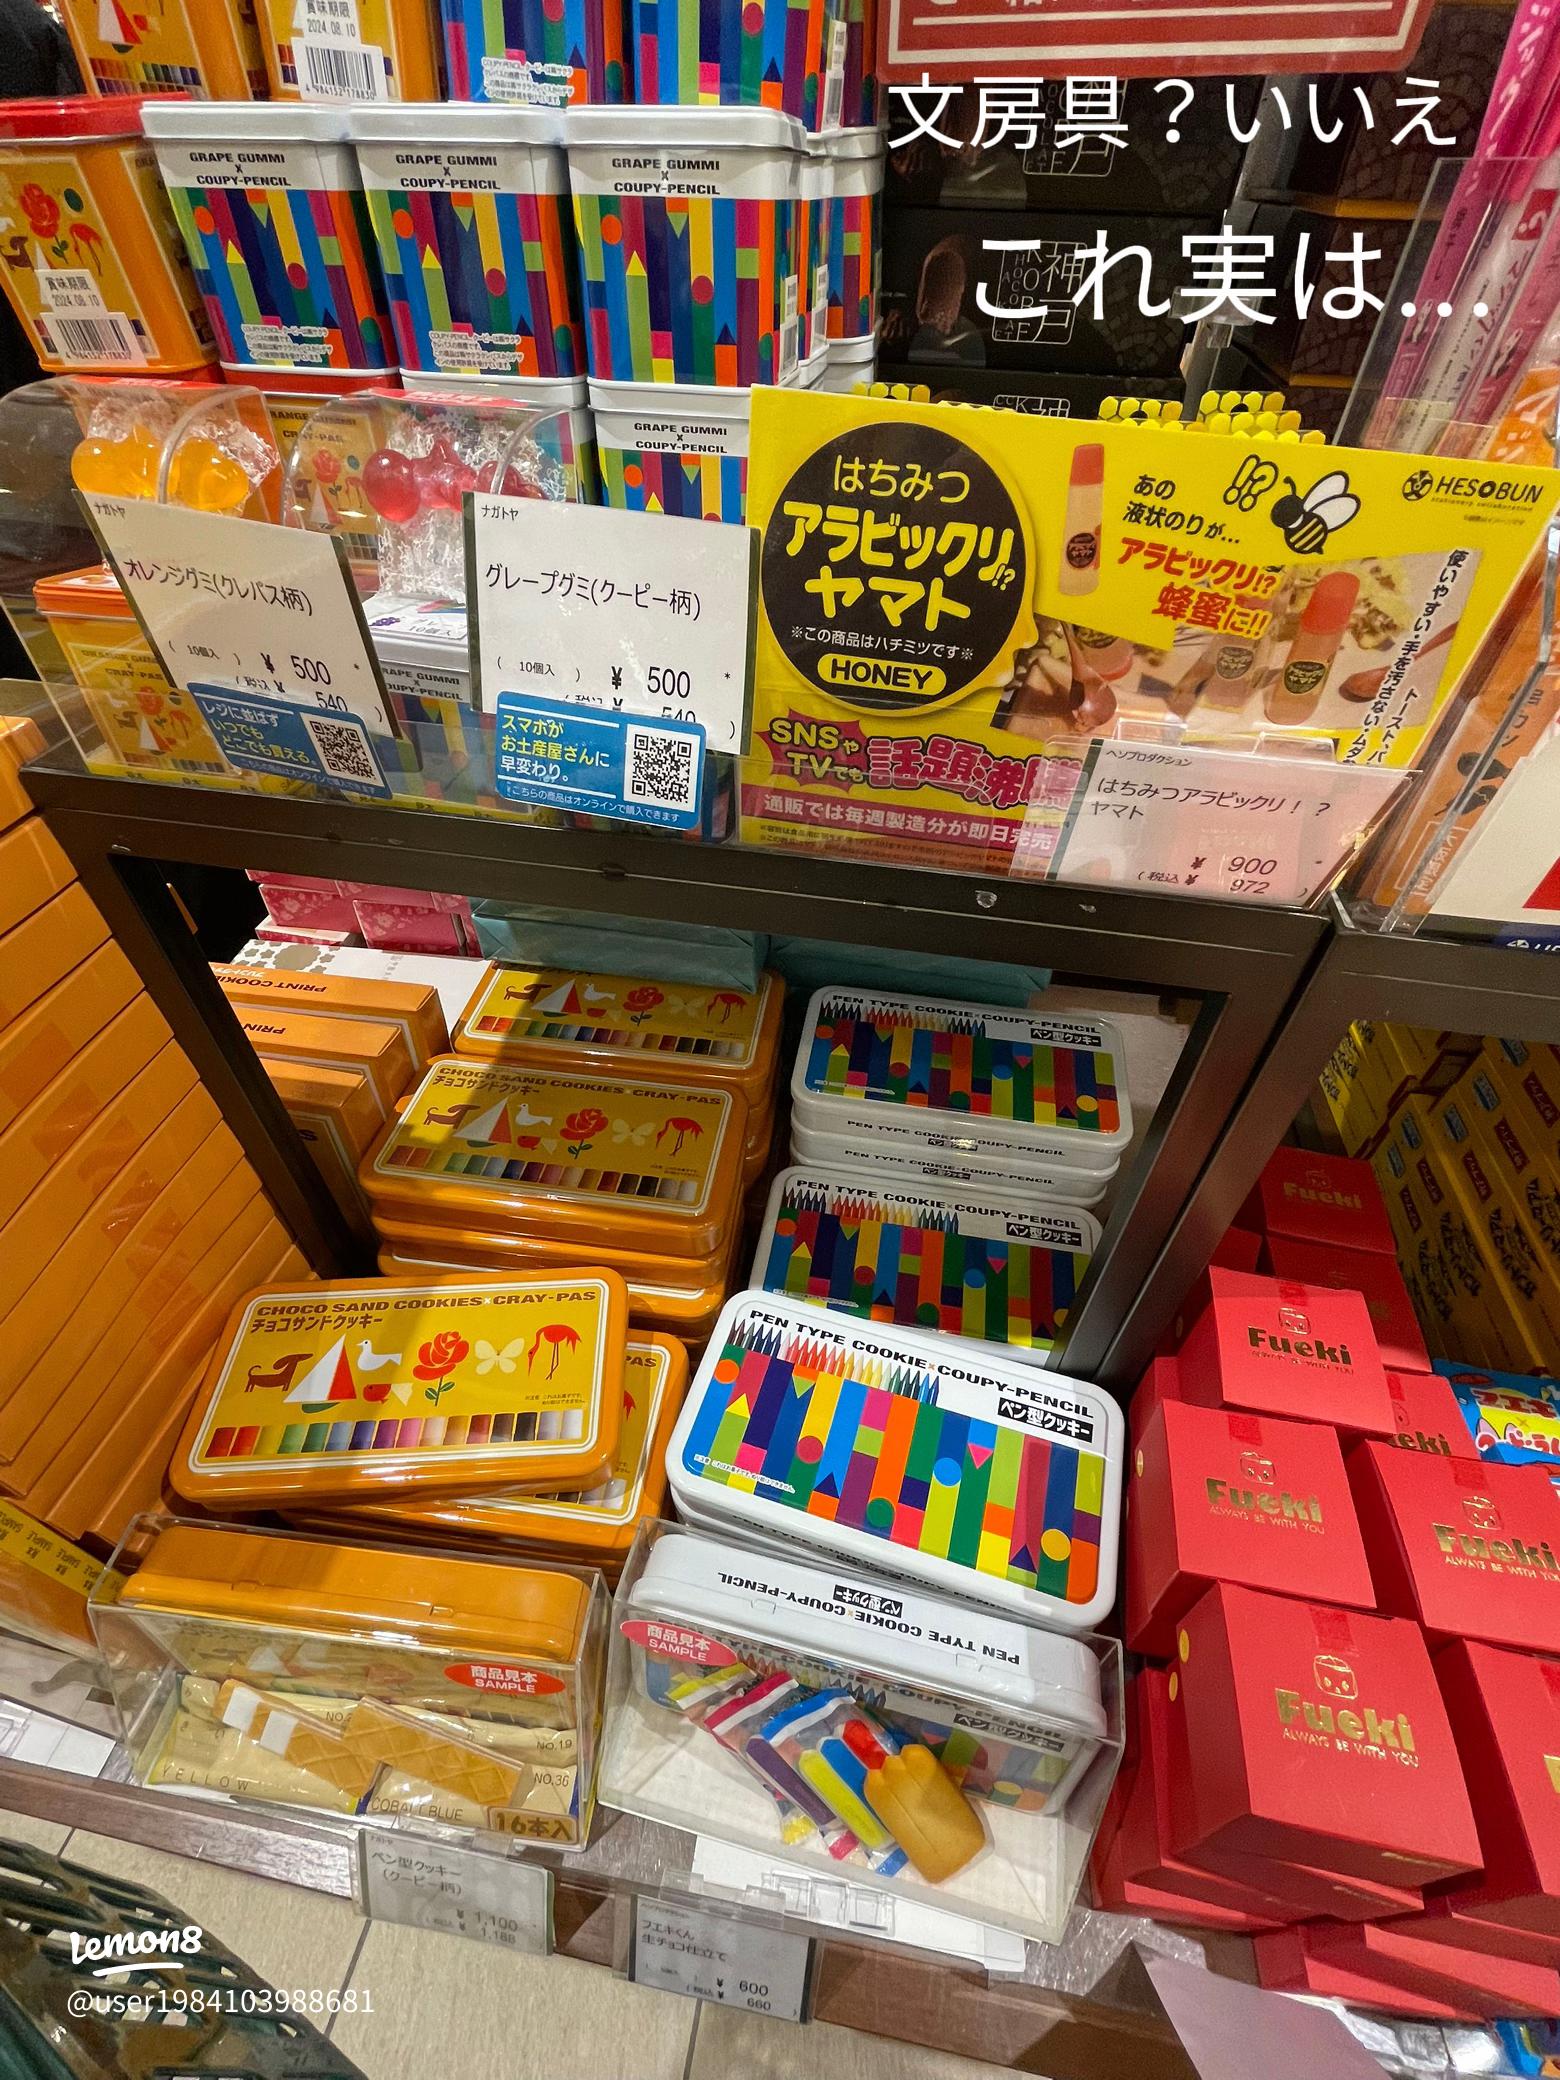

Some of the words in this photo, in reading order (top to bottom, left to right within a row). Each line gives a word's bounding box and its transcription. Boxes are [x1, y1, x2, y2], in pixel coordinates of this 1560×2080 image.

[190, 152, 233, 163] GRAPE
[237, 153, 285, 163] GUMMI
[396, 154, 443, 166] GRAPE
[446, 155, 498, 167] GUMMI
[612, 158, 661, 170] GRAPE
[666, 159, 720, 170] GUMMI
[196, 175, 292, 187] COUPY-PENCIL
[400, 177, 501, 190] COUPY-PENCIL
[613, 182, 720, 195] COUPY-PENCIL
[634, 422, 677, 434] GRAPE
[680, 424, 728, 436] GUMMI
[635, 440, 728, 454] COUPY-PENCIL
[834, 454, 970, 504] はちみつ
[1134, 474, 1176, 498] あの
[1435, 475, 1544, 504] HESOBUN
[95, 502, 126, 518] ナガトヤ
[481, 505, 519, 521] ナガトヤ
[124, 558, 313, 616] オレンジグミ(クレパス柄)
[485, 563, 701, 622] グレープグミ(クーピー柄)
[804, 564, 970, 632] ヤマト
[187, 644, 220, 660] 10個入
[290, 655, 332, 686] 500
[382, 667, 413, 678] RAPE
[416, 672, 461, 686] GUMMI
[830, 657, 933, 691] HONEY
[518, 661, 556, 677] 10個入
[646, 666, 692, 699] 500
[202, 701, 281, 726] レジに並ばず
[315, 691, 348, 713] 540
[213, 720, 265, 740] いつでも
[501, 714, 565, 737] スマホが
[1365, 688, 1419, 765] トースト、パ
[500, 734, 610, 768] お土産屋さんに
[1105, 748, 1193, 767] ヘソプロダクション
[500, 755, 569, 783] 早変わり。
[1091, 801, 1144, 820] ヤマト
[1227, 856, 1278, 876] 900
[1229, 879, 1271, 896] 972
[281, 982, 327, 993] PRINT
[832, 995, 864, 1006] PEN
[871, 998, 909, 1011] TYPE
[914, 1005, 974, 1018] COOKIE
[981, 1012, 1101, 1035] COUPY-PENCIL
[243, 1022, 287, 1035] PRIN
[1031, 1028, 1102, 1047] ペン型クッキー
[432, 1075, 541, 1097] チョコサンドクッキー
[438, 1067, 497, 1081] CHOCO
[498, 1073, 547, 1087] SAND
[550, 1079, 625, 1095] COOKIES
[632, 1089, 721, 1106] CRAY-PAS
[847, 1119, 873, 1130] PEN
[877, 1125, 910, 1134] TYPE
[845, 1149, 870, 1159] PEN
[874, 1155, 906, 1164] TYPE
[909, 1160, 956, 1172] COOKIE
[961, 1166, 1055, 1185] COUPY-PENCIL
[796, 1179, 830, 1192] PEN
[835, 1185, 878, 1199] TYPE
[883, 1193, 946, 1210] COOKIE
[954, 1203, 1081, 1230] COUPY-PENCIL
[1006, 1222, 1082, 1247] ペン型クッキー
[256, 1302, 328, 1317] CHOCO
[332, 1299, 389, 1314] SAND
[393, 1296, 483, 1312] COOKIES
[492, 1290, 597, 1306] CRAY-PAS
[250, 1314, 384, 1334] チョコサンドクッキー
[1247, 1325, 1352, 1366] Fueki
[750, 1309, 791, 1328] PEN
[795, 1321, 847, 1343] TYPE
[851, 1338, 928, 1371] COOKIE
[936, 1362, 1095, 1419] COUPY-PENCIL
[997, 1397, 1095, 1445] ペン型クッキー
[1393, 1430, 1450, 1456] eki
[1205, 1477, 1323, 1523] Fueki
[1209, 1505, 1249, 1520] ALWAYS
[1269, 1516, 1298, 1530] WITH
[1302, 1522, 1325, 1535] YOU
[1431, 1522, 1560, 1571] Fueki
[1444, 1555, 1487, 1570] ALWAYS
[1506, 1565, 1537, 1579] WITH
[717, 1570, 846, 1618] COUPY-PENCIL
[833, 1585, 903, 1618] ペン型クッキー
[854, 1610, 923, 1637] COOKIE
[646, 1623, 711, 1652] 商品見本
[928, 1629, 976, 1652] TYPE
[647, 1638, 708, 1662] SAMPLE
[982, 1644, 1021, 1666] PEN
[470, 1664, 538, 1685] 商品見本
[474, 1678, 536, 1694] SAMPLE
[1274, 1687, 1416, 1752] Fueki
[536, 1739, 573, 1751] NO.19
[1282, 1727, 1330, 1748] ALWAYS
[1335, 1738, 1350, 1753] BE
[1353, 1742, 1388, 1761] WITH
[1391, 1750, 1420, 1768] YOU
[534, 1772, 570, 1787] NO.36
[428, 1804, 464, 1822] BLUE
[372, 1852, 463, 1877] ペン型クッキー
[474, 1911, 519, 1932] 1,100
[641, 1918, 696, 1942] フエキくん
[641, 1933, 728, 1963] 生チョコ仕立て
[739, 1980, 770, 1997] 600
[747, 1998, 772, 2012] 660
